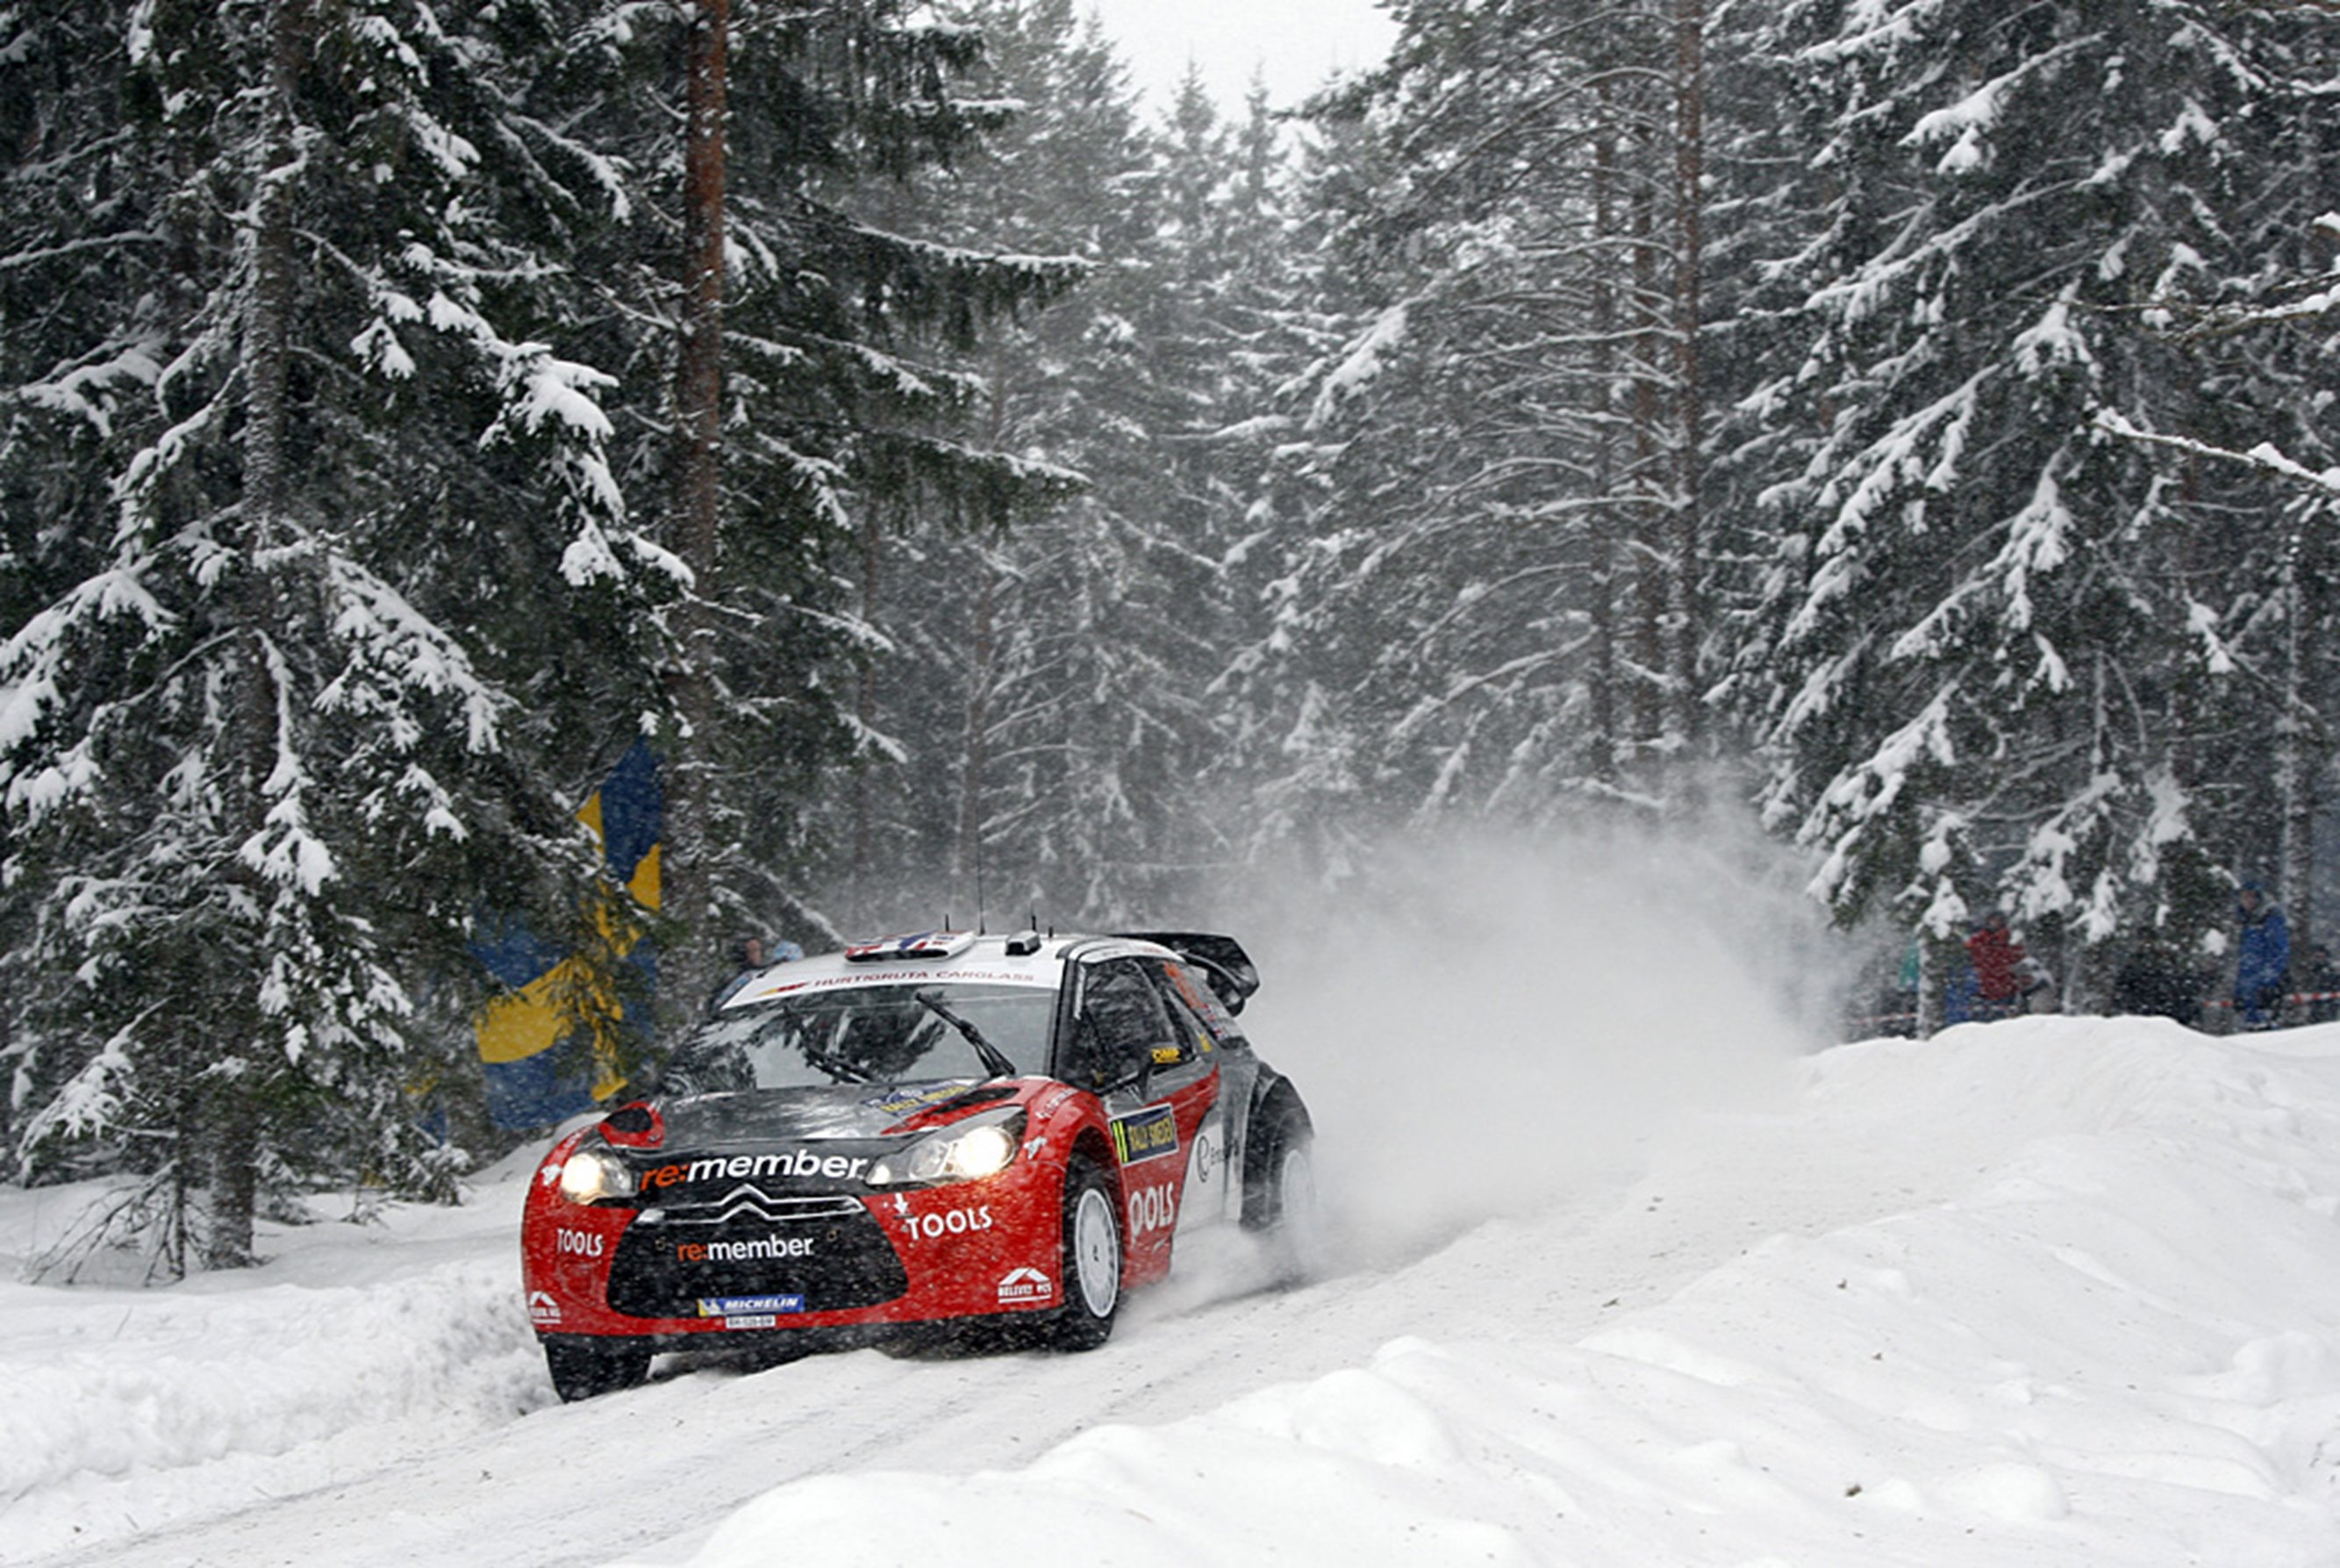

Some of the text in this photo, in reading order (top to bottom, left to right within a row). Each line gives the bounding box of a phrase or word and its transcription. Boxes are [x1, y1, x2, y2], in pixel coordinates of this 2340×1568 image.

[639, 1149, 869, 1191] re:member
[905, 1206, 993, 1241] TOOLS
[557, 1228, 604, 1257] TOOLS
[676, 1234, 813, 1262] re:member
[724, 1297, 799, 1311] MICHELIN
